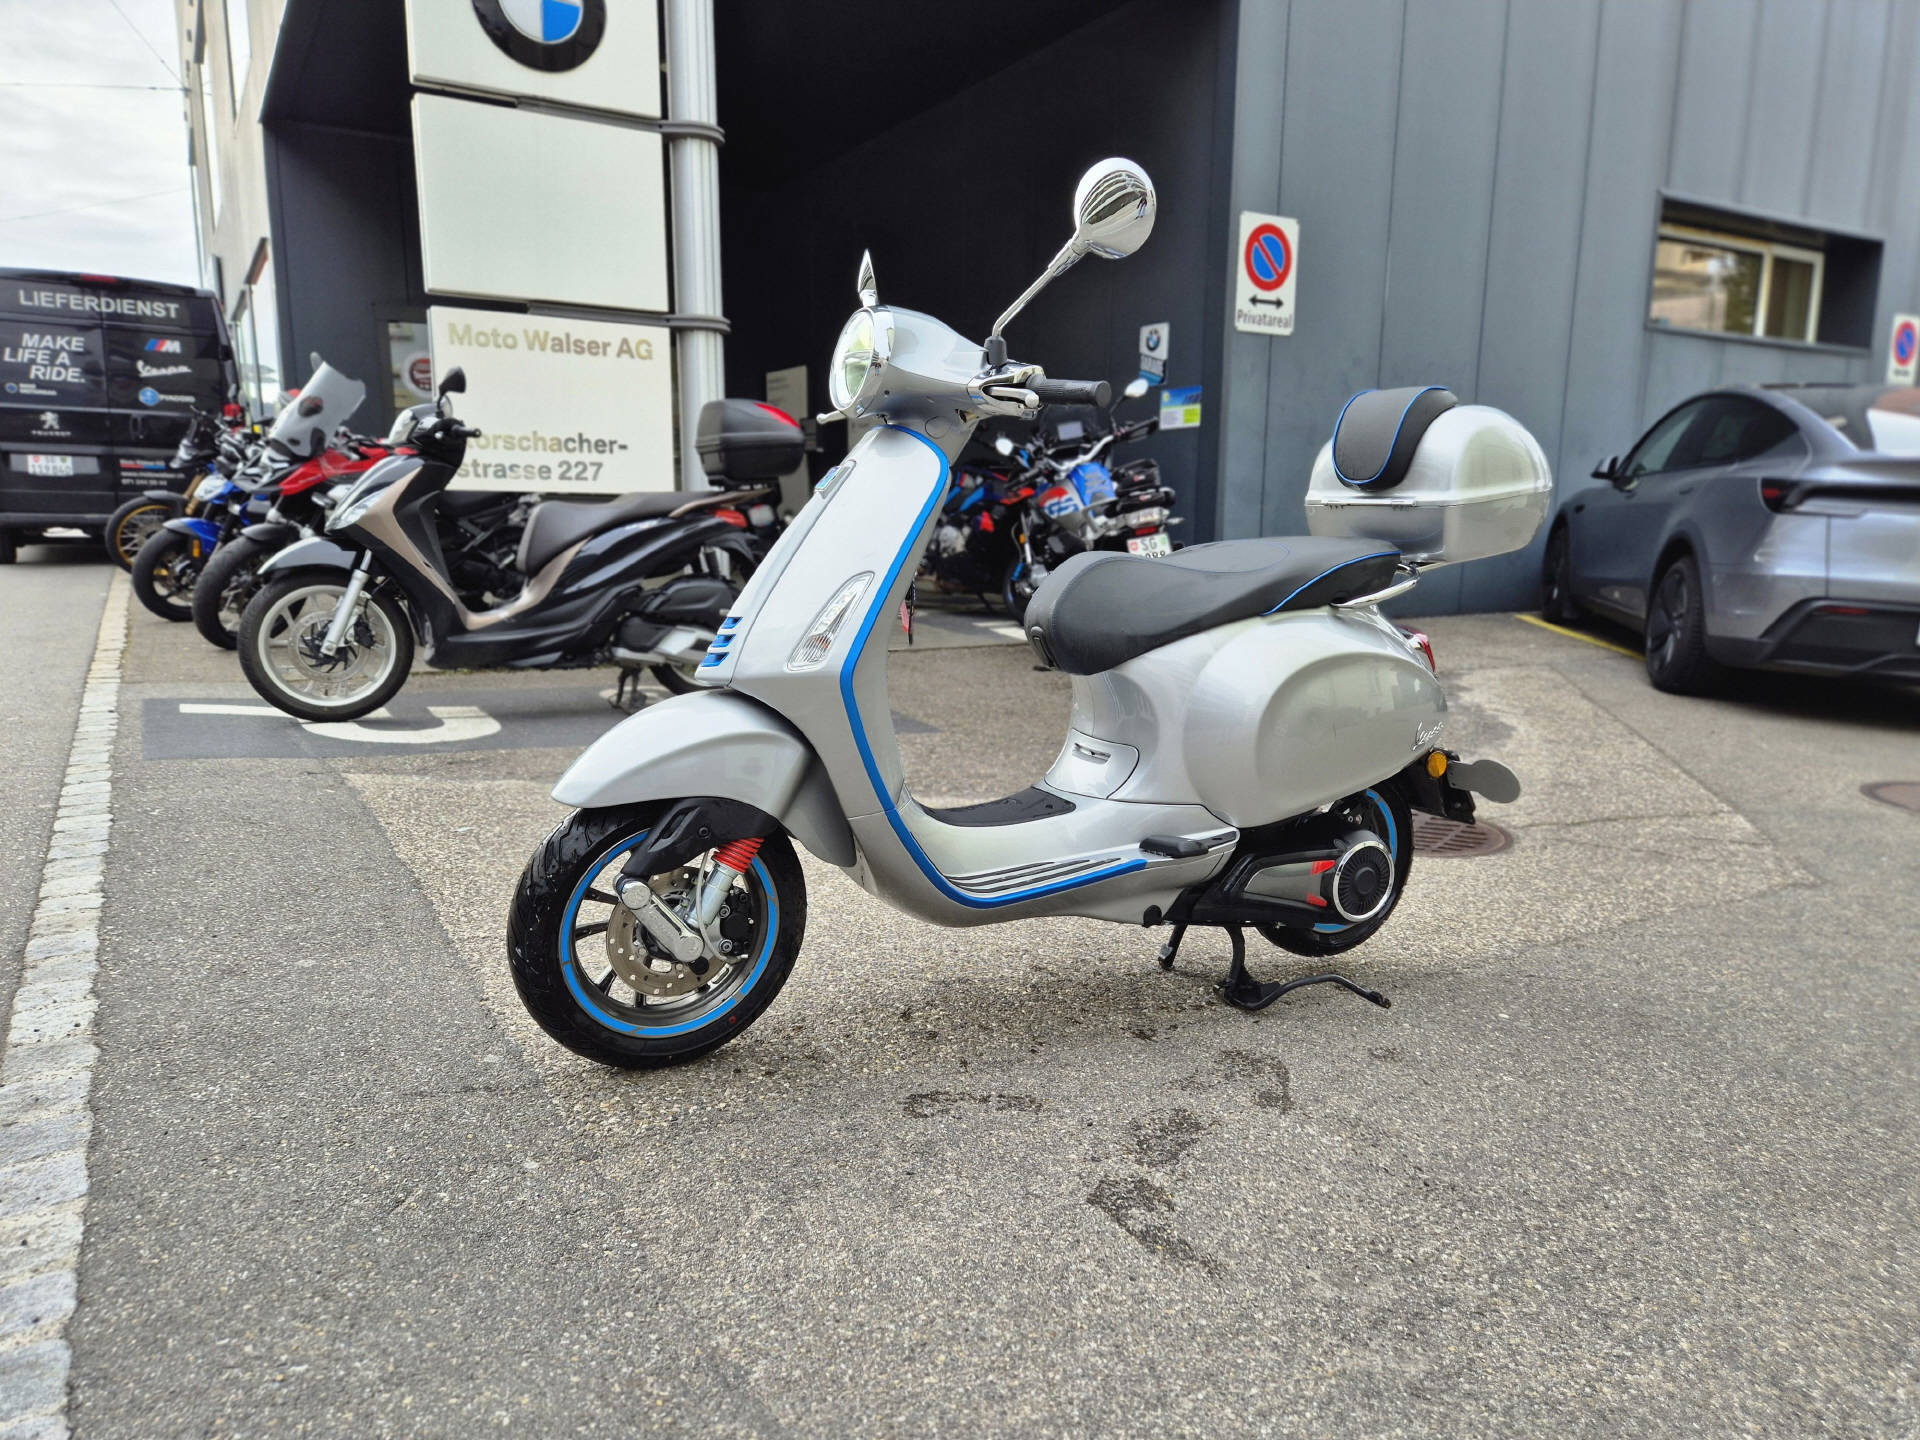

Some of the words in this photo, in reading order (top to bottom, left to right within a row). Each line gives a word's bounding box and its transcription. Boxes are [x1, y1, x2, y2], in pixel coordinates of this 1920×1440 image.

[19, 289, 180, 318] LIEFERDIENST
[1236, 309, 1293, 329] Privatareal
[22, 333, 85, 352] MAKE
[448, 322, 518, 350] Moto
[523, 327, 611, 357] Walser
[616, 337, 653, 360] AG
[4, 347, 51, 364] LIFE
[55, 351, 70, 366] A
[30, 365, 86, 383] RIDE.
[466, 430, 628, 454] orschacher-
[456, 459, 552, 480] strasse
[557, 460, 604, 481] 227
[1140, 535, 1159, 552] SG
